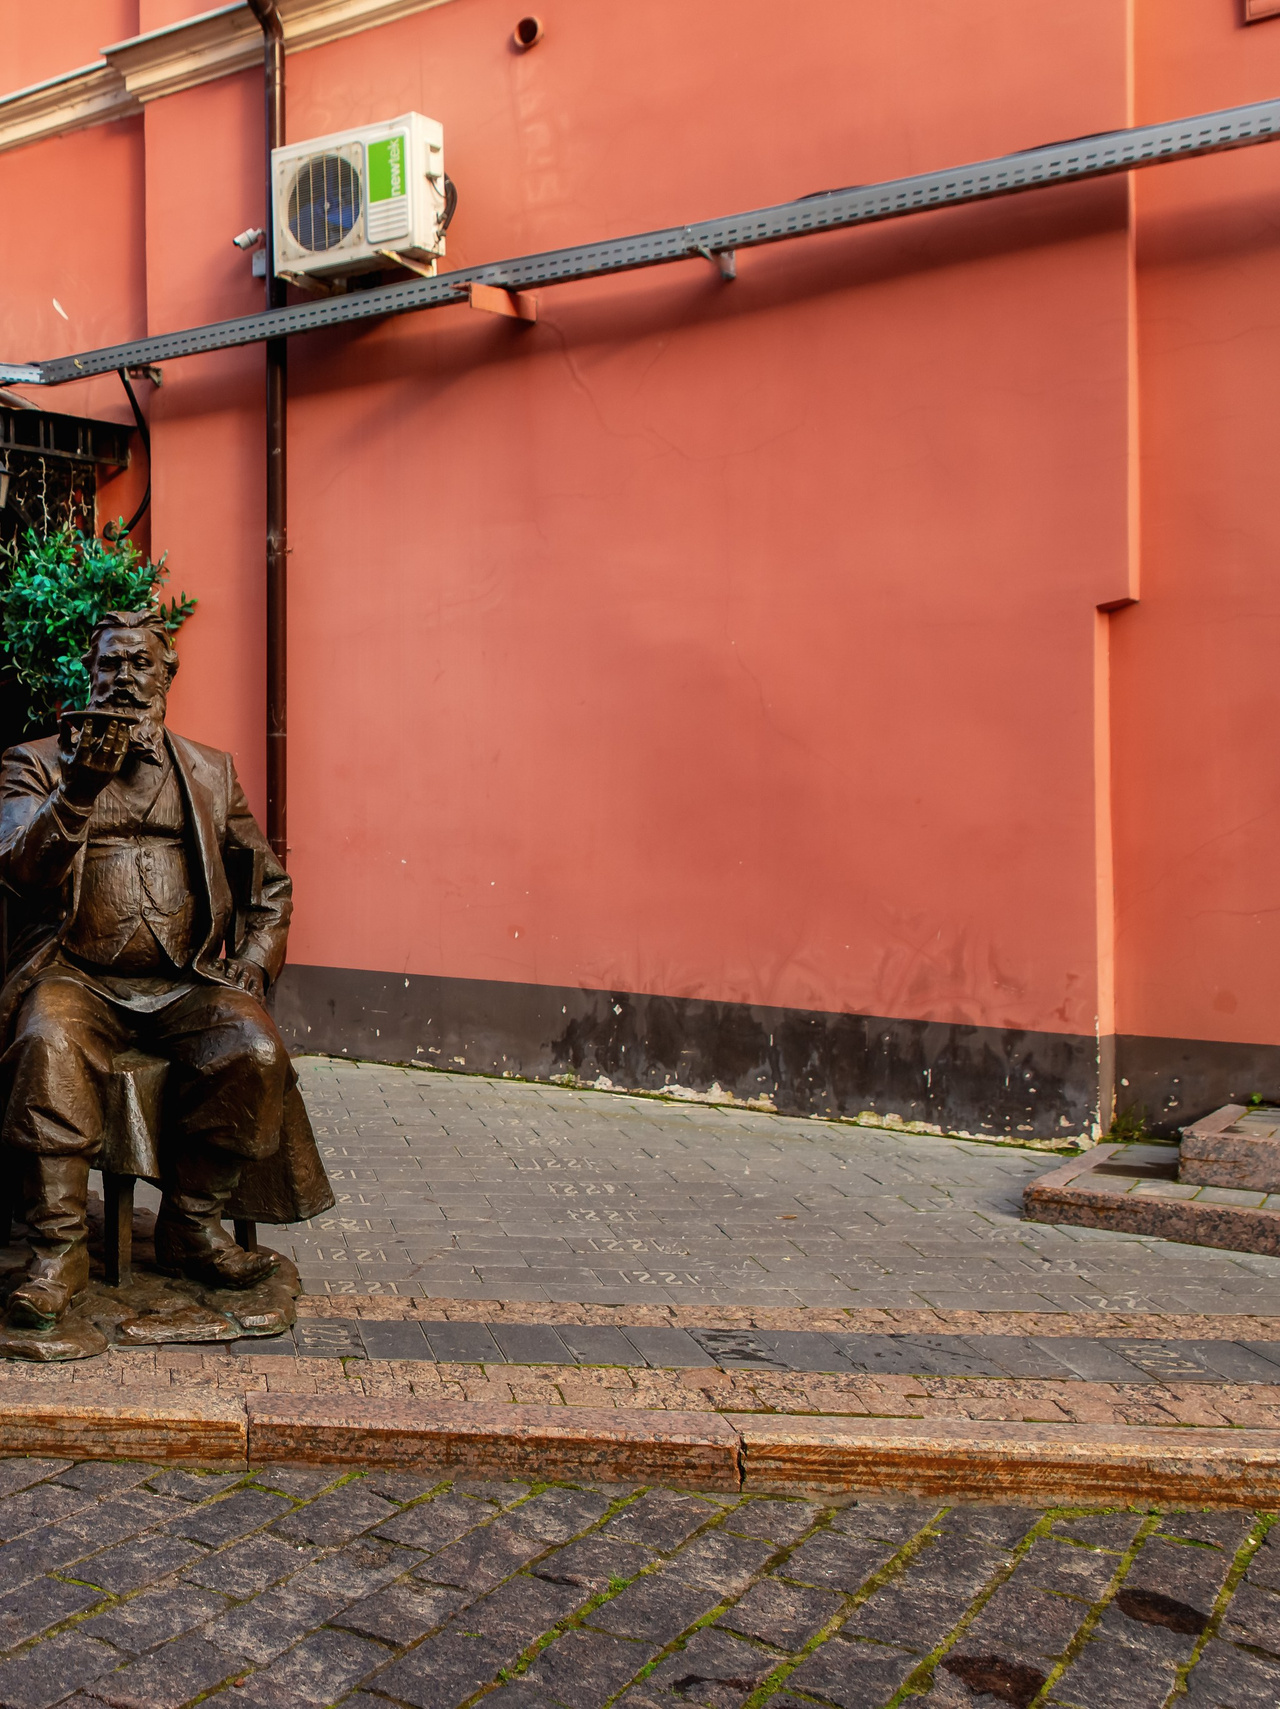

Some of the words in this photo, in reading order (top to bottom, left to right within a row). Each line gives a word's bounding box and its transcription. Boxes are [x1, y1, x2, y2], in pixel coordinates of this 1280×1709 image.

[387, 138, 401, 198] newtek
[316, 1127, 341, 1135] 21
[322, 1147, 348, 1156] 21
[329, 1169, 357, 1180] 21
[336, 1193, 370, 1205] 21
[316, 1249, 388, 1262] 1221
[619, 1270, 701, 1286] 1221
[323, 1280, 400, 1295] 1221
[1070, 1294, 1167, 1311] 1221
